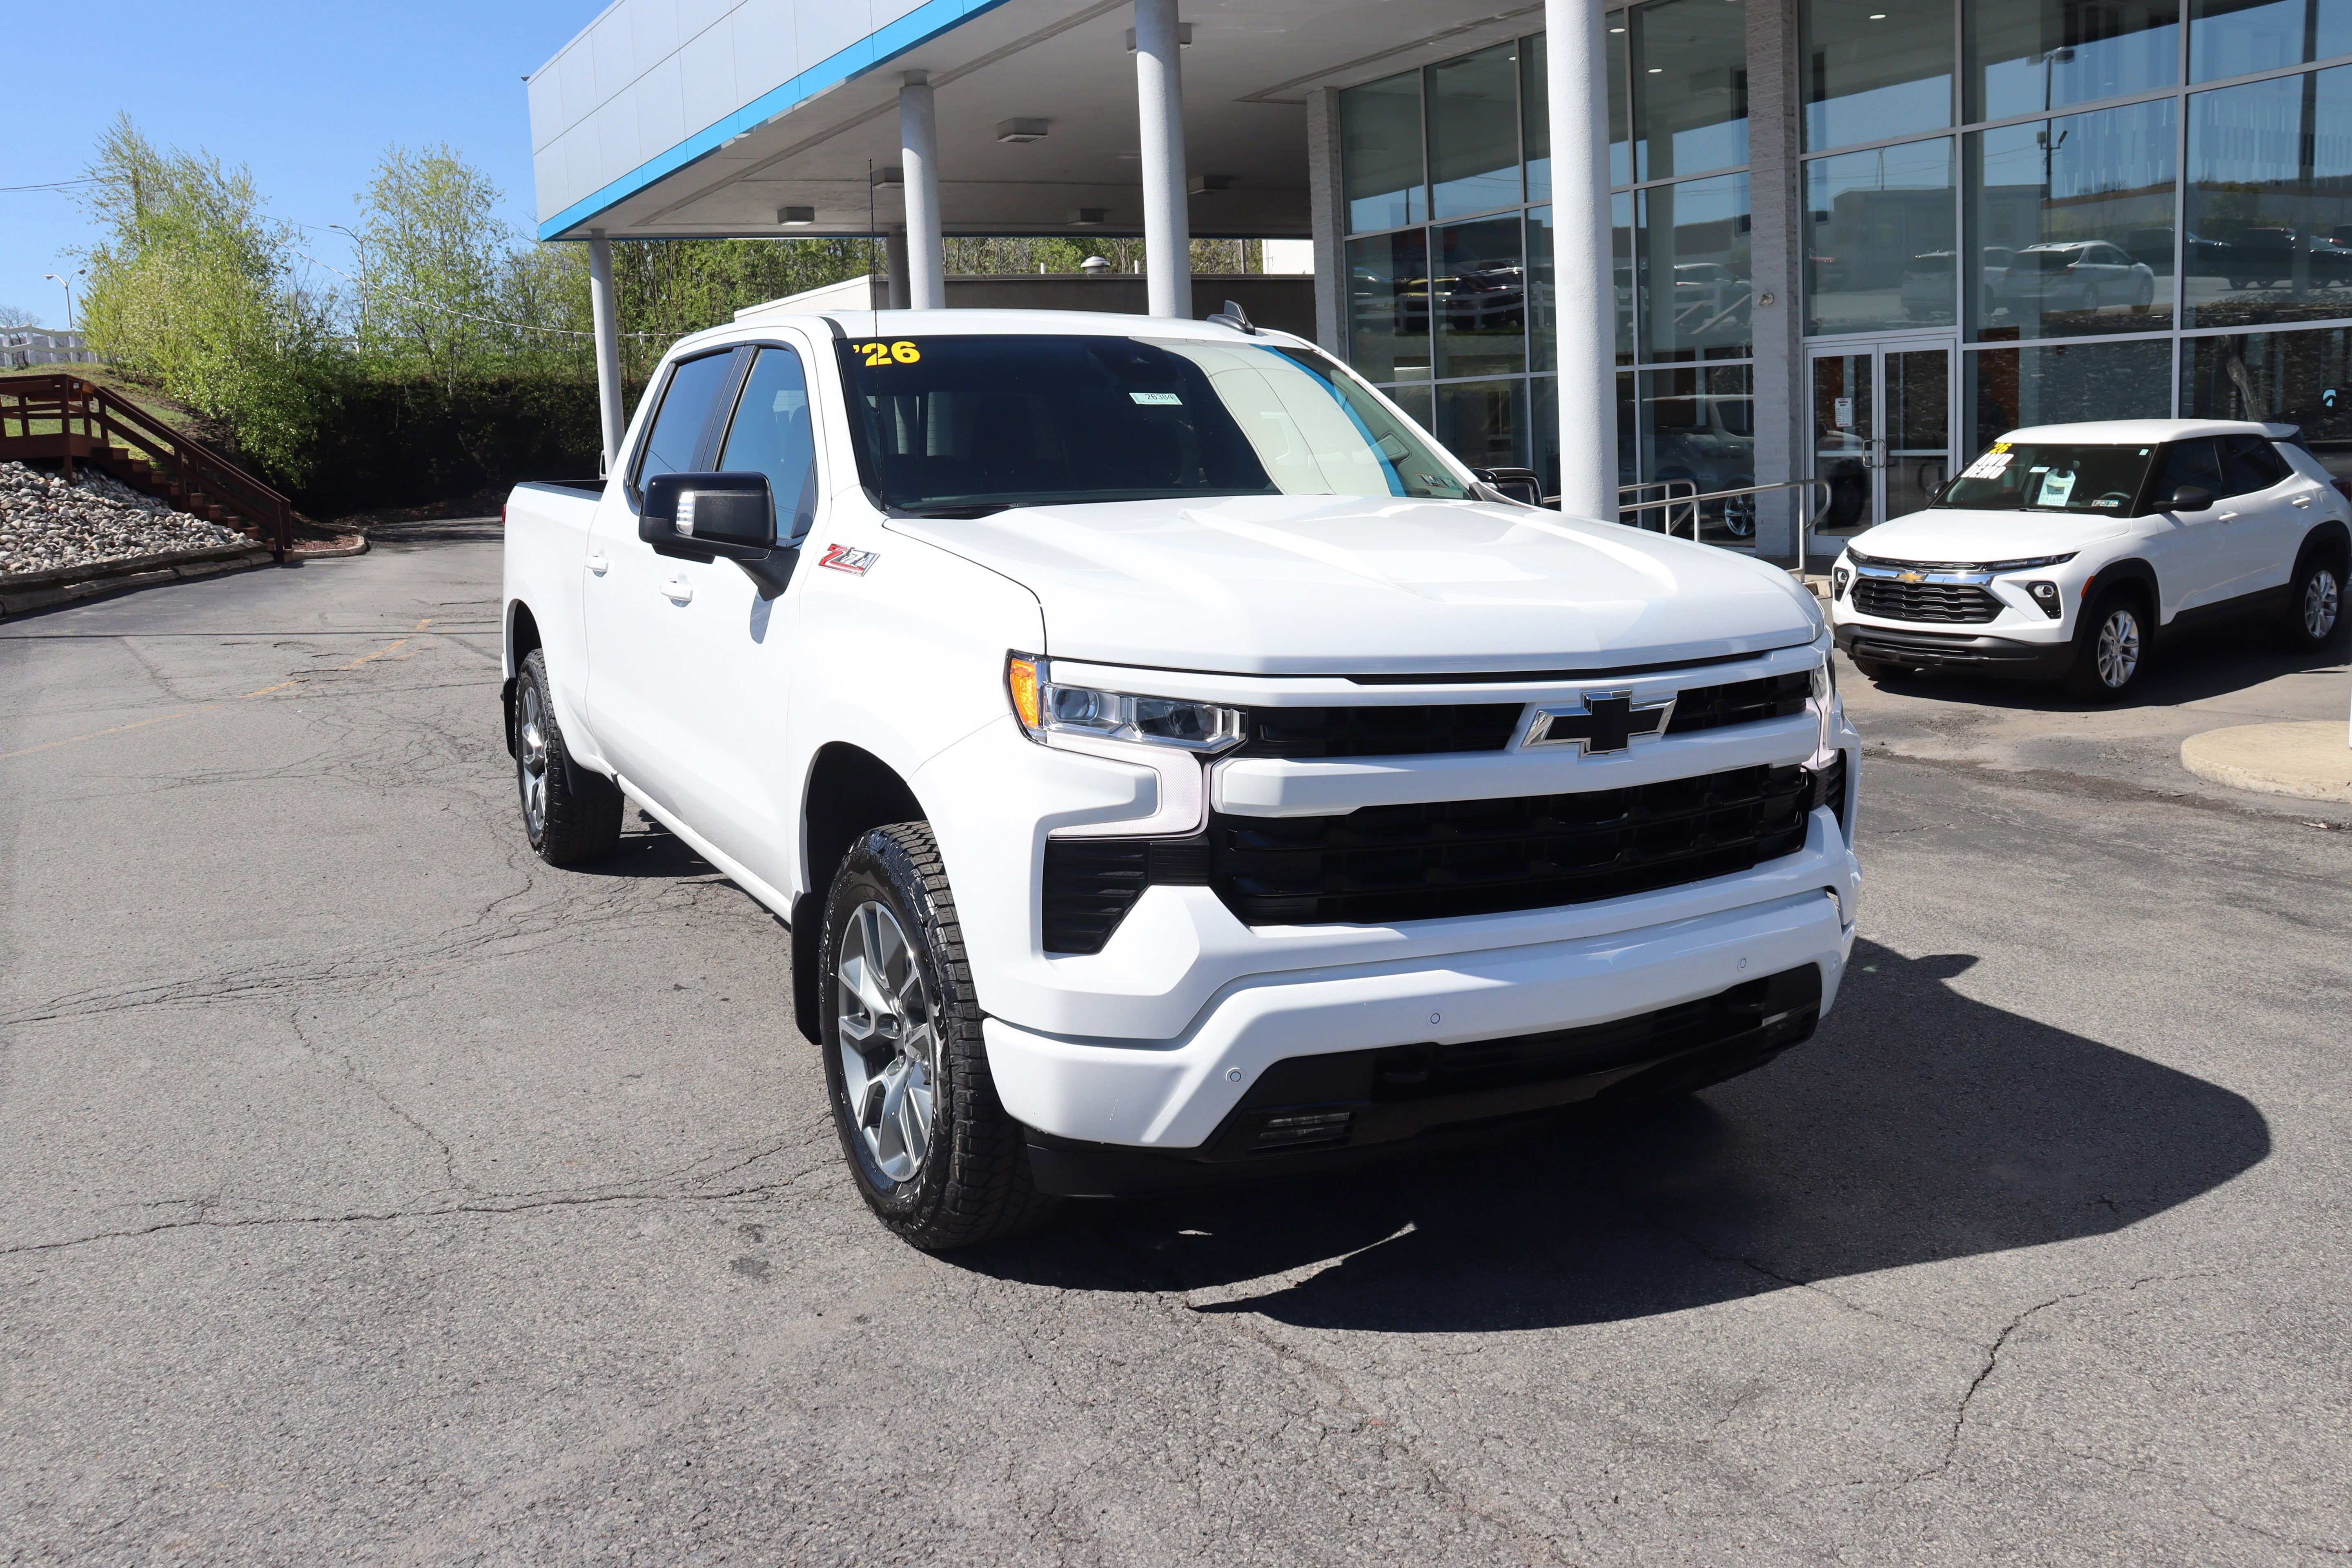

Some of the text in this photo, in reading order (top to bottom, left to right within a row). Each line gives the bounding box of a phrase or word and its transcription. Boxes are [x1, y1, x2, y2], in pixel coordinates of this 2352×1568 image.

[853, 341, 921, 367] '26
[1973, 453, 2014, 466] AWD
[1960, 465, 2007, 479] DEMO
[818, 543, 880, 577] Z71
